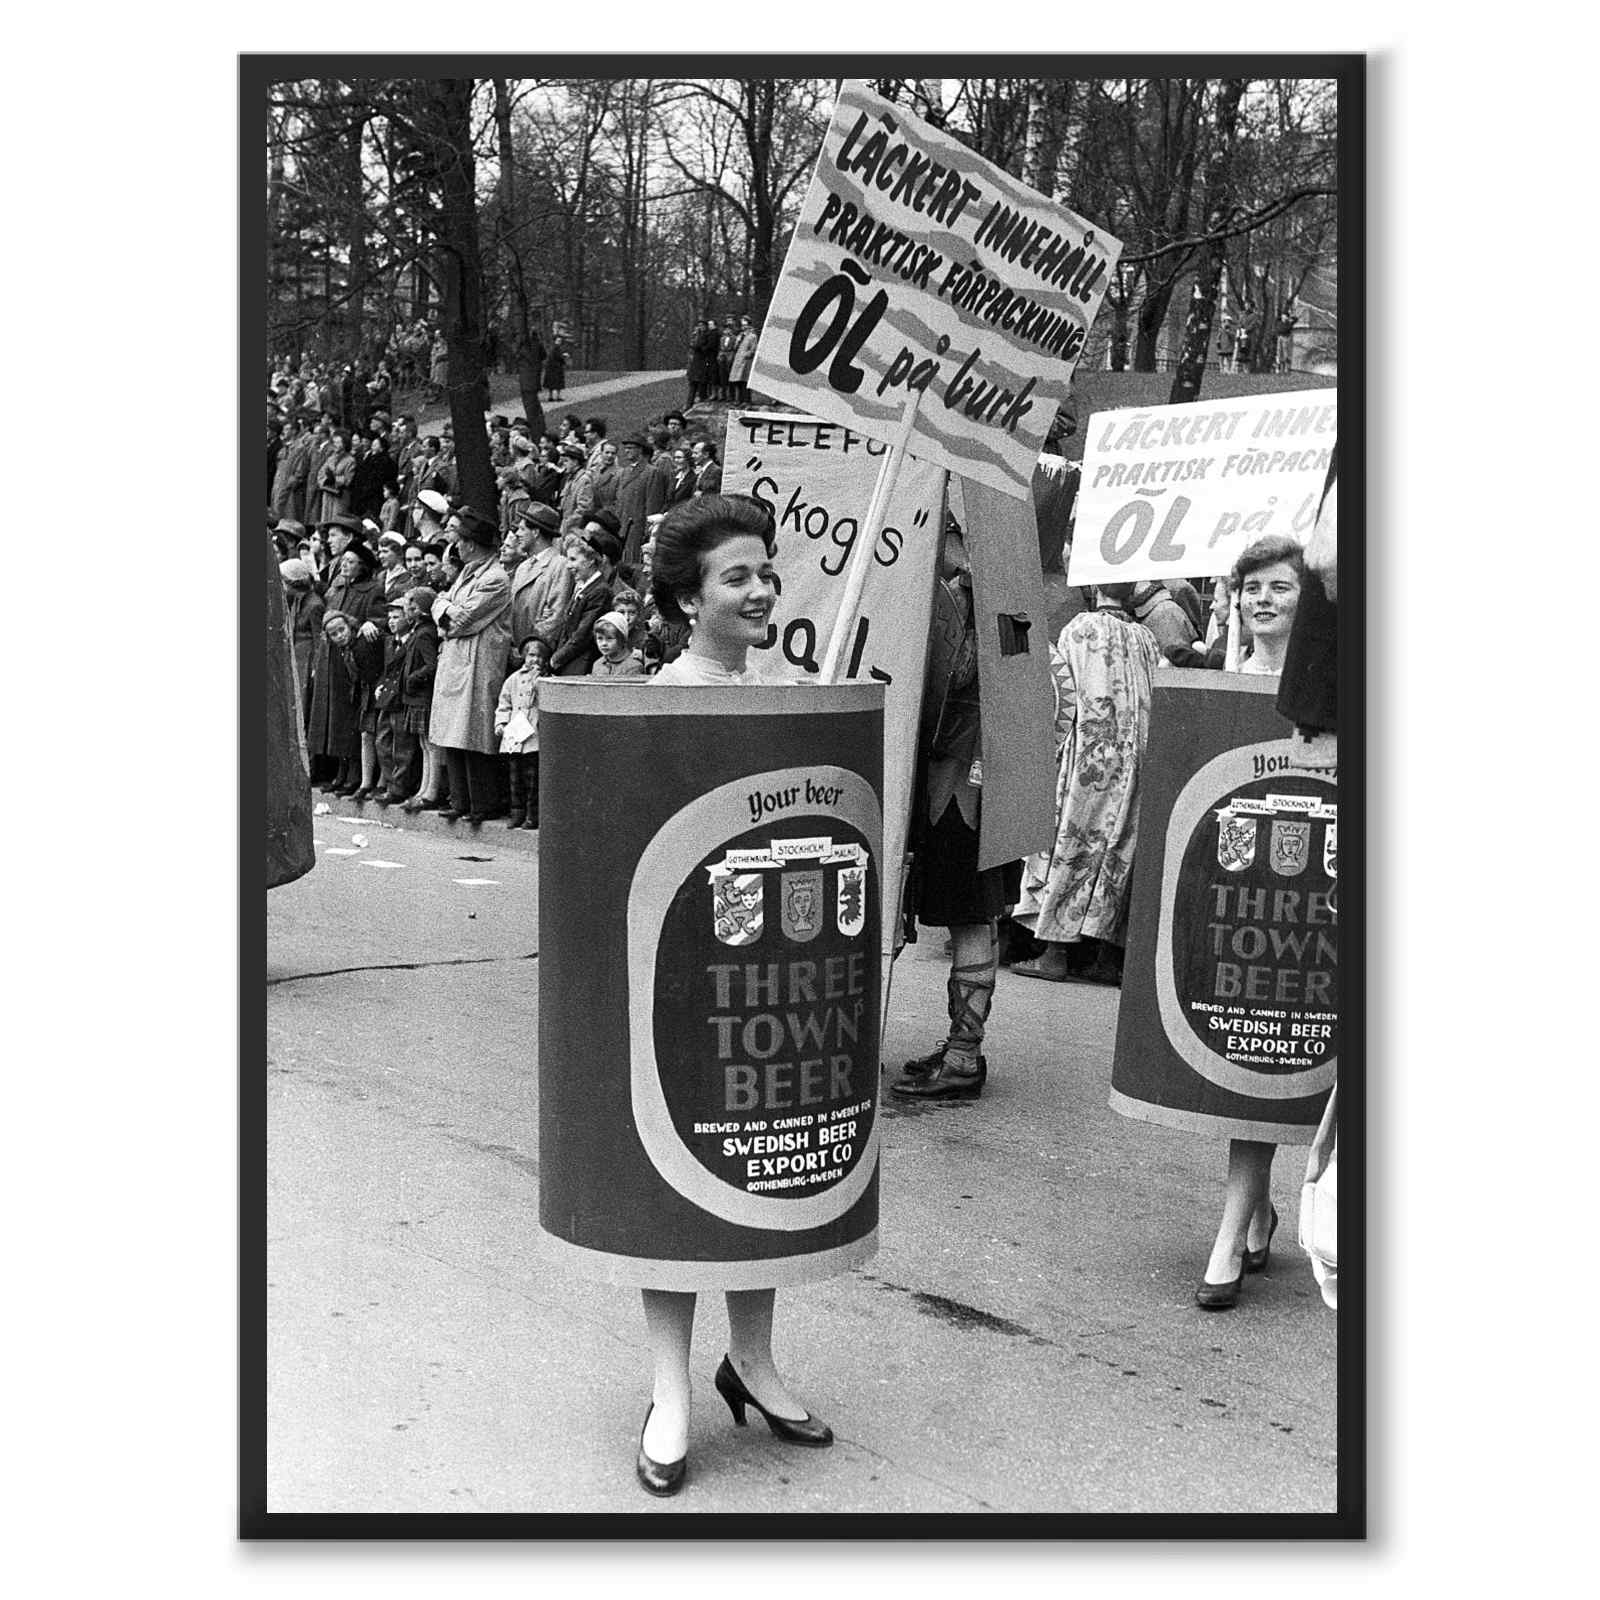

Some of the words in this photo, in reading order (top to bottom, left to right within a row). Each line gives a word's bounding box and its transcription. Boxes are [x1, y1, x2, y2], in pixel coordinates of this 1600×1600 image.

[813, 192, 943, 290] PRAKTISK
[974, 201, 1106, 304] INNEHÅLL
[876, 334, 950, 397] på
[943, 348, 1037, 433] burk
[1092, 457, 1216, 489] PRAKTISK
[1207, 496, 1279, 549] på
[805, 778, 843, 806] beer
[1272, 799, 1316, 808] STOCKHOLM
[777, 843, 824, 856] STOCKHOLM
[706, 951, 864, 1008] THREE
[1214, 961, 1332, 1004] BEER
[1191, 1001, 1225, 1013] BREWED
[1227, 1006, 1245, 1015] AND
[1250, 1008, 1287, 1018] CANNED
[1291, 1012, 1301, 1020] IN
[1304, 1012, 1337, 1021] SWEDEN
[1208, 1016, 1281, 1036] SWEDISH
[1291, 1023, 1332, 1038] BEER
[1227, 1036, 1299, 1054] EXPORT
[1304, 1039, 1326, 1055] CO
[724, 1054, 853, 1111] BEER
[694, 1122, 740, 1134] BREWED
[744, 1120, 767, 1132] AND
[773, 1115, 814, 1131] CANNED
[817, 1112, 828, 1123] IN
[831, 1105, 860, 1121] SWEDEN
[722, 1131, 809, 1157] SWEDISH
[819, 1121, 857, 1146] BEER
[747, 1150, 828, 1177] EXPORT
[832, 1143, 851, 1163] CO
